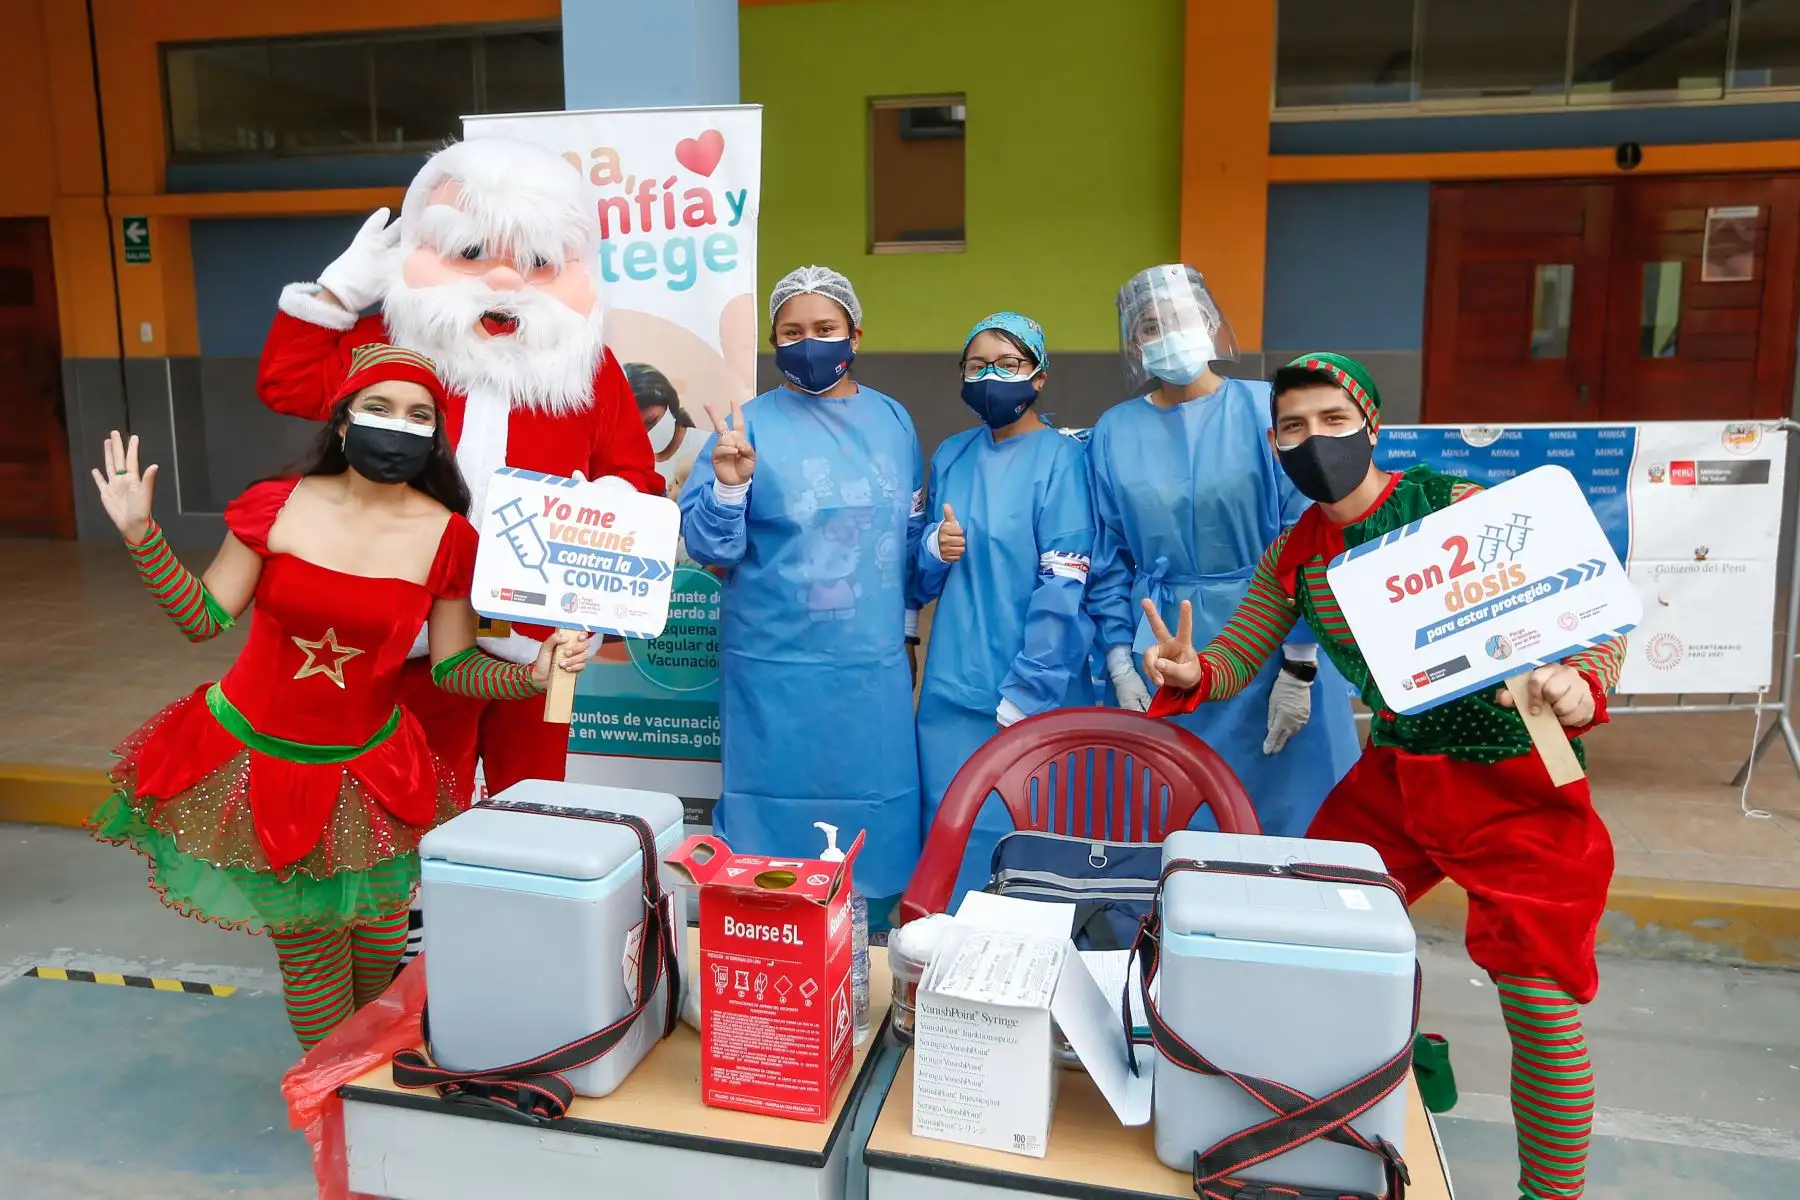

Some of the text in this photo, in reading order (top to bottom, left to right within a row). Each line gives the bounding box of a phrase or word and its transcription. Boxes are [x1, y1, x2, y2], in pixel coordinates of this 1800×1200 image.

[562, 147, 636, 195] a,
[725, 189, 747, 227] y
[1389, 431, 1418, 439] MINSA
[1549, 431, 1577, 440] MINSA
[1597, 430, 1626, 439] MINSA
[1388, 448, 1624, 458] MINSA MINSA MINSA MINSA MINSA
[1488, 469, 1516, 477] MINSA
[1592, 468, 1620, 476] MINSA
[1672, 467, 1693, 477] PERÚ
[1589, 486, 1616, 494] MINSA
[542, 495, 616, 528] Yo me
[549, 522, 636, 552] vacuné
[558, 550, 632, 573] contra la
[1385, 535, 1476, 603] Son 2
[1655, 564, 1700, 574] Gobierno
[1702, 564, 1718, 573] del
[563, 569, 649, 597] COVID-19
[1444, 562, 1526, 612] dosis
[709, 607, 720, 620] al
[1426, 582, 1552, 643] para estar protegido
[647, 638, 703, 653] Regular
[647, 653, 720, 668] Vacunació
[570, 711, 720, 730] puntos de vacunació
[579, 728, 596, 739] en
[601, 730, 721, 747] www.minsa.gob
[724, 915, 804, 946] Boarse 5L
[981, 1012, 1019, 1029] Syringe
[1013, 1134, 1026, 1144] 100
